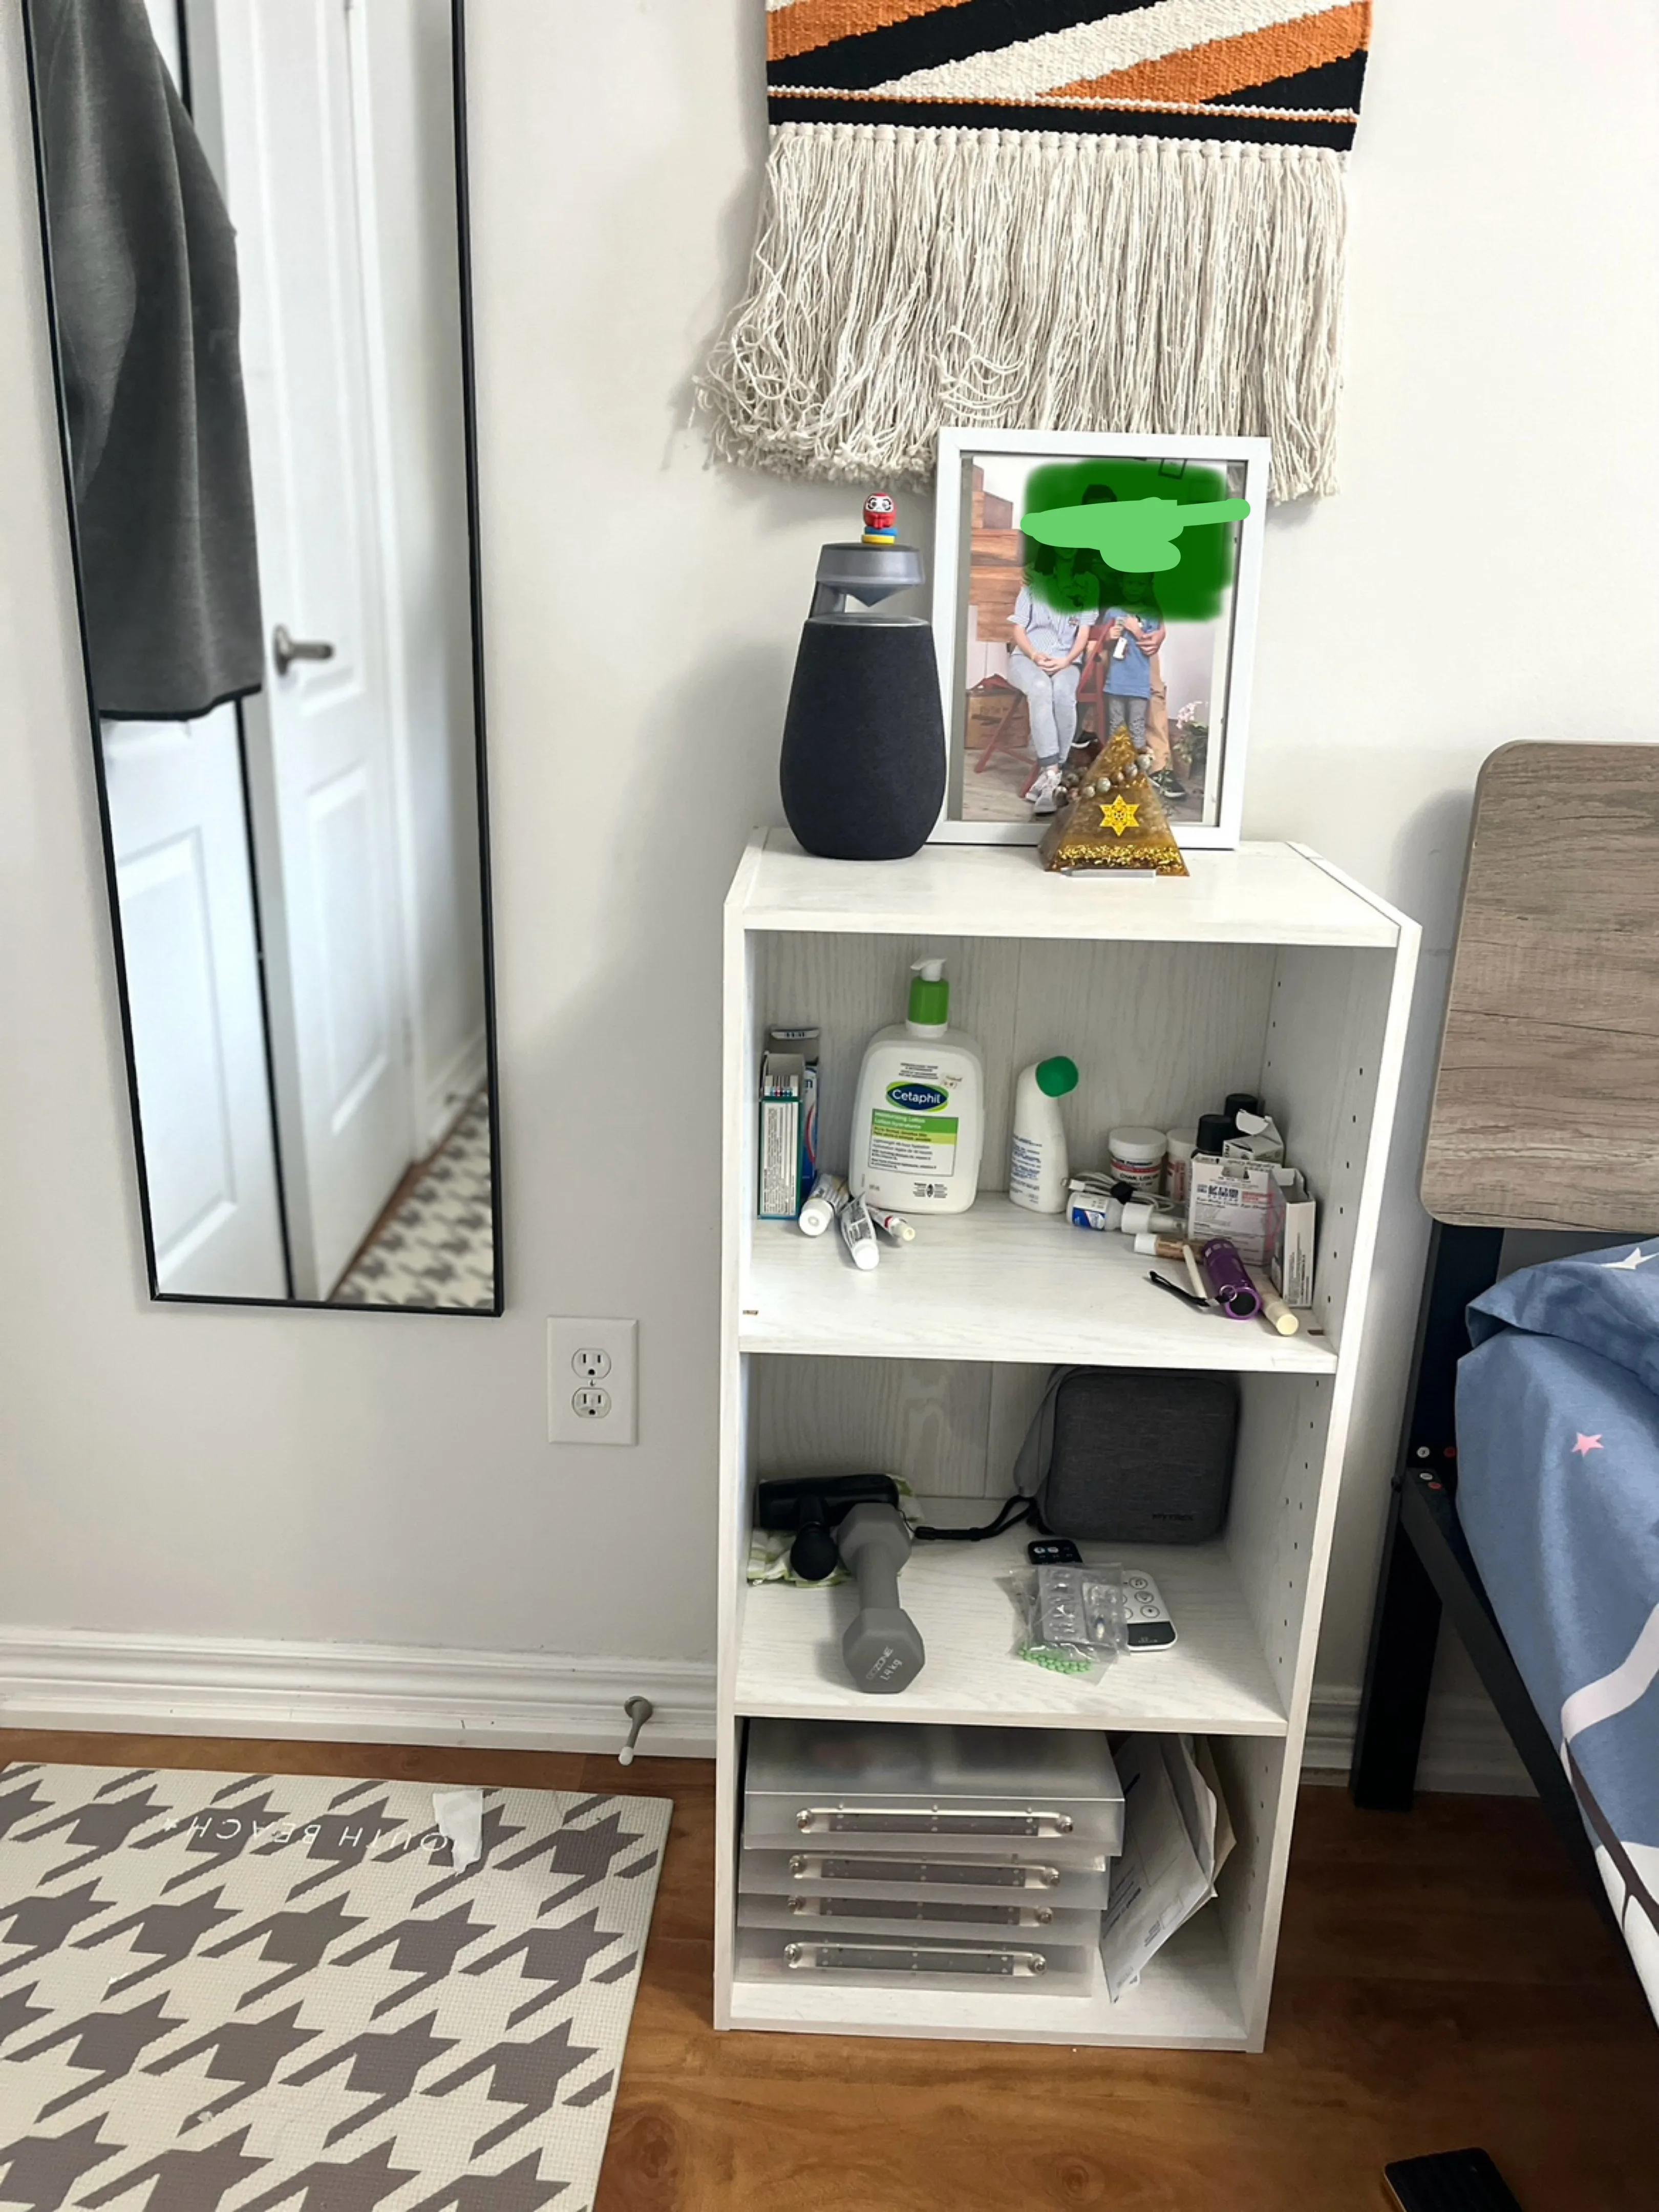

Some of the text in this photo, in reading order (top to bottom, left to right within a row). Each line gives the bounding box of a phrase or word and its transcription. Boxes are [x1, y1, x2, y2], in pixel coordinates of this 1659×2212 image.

[892, 1089, 941, 1104] Cetaphil
[186, 1816, 448, 1852] OUTH BEACH
